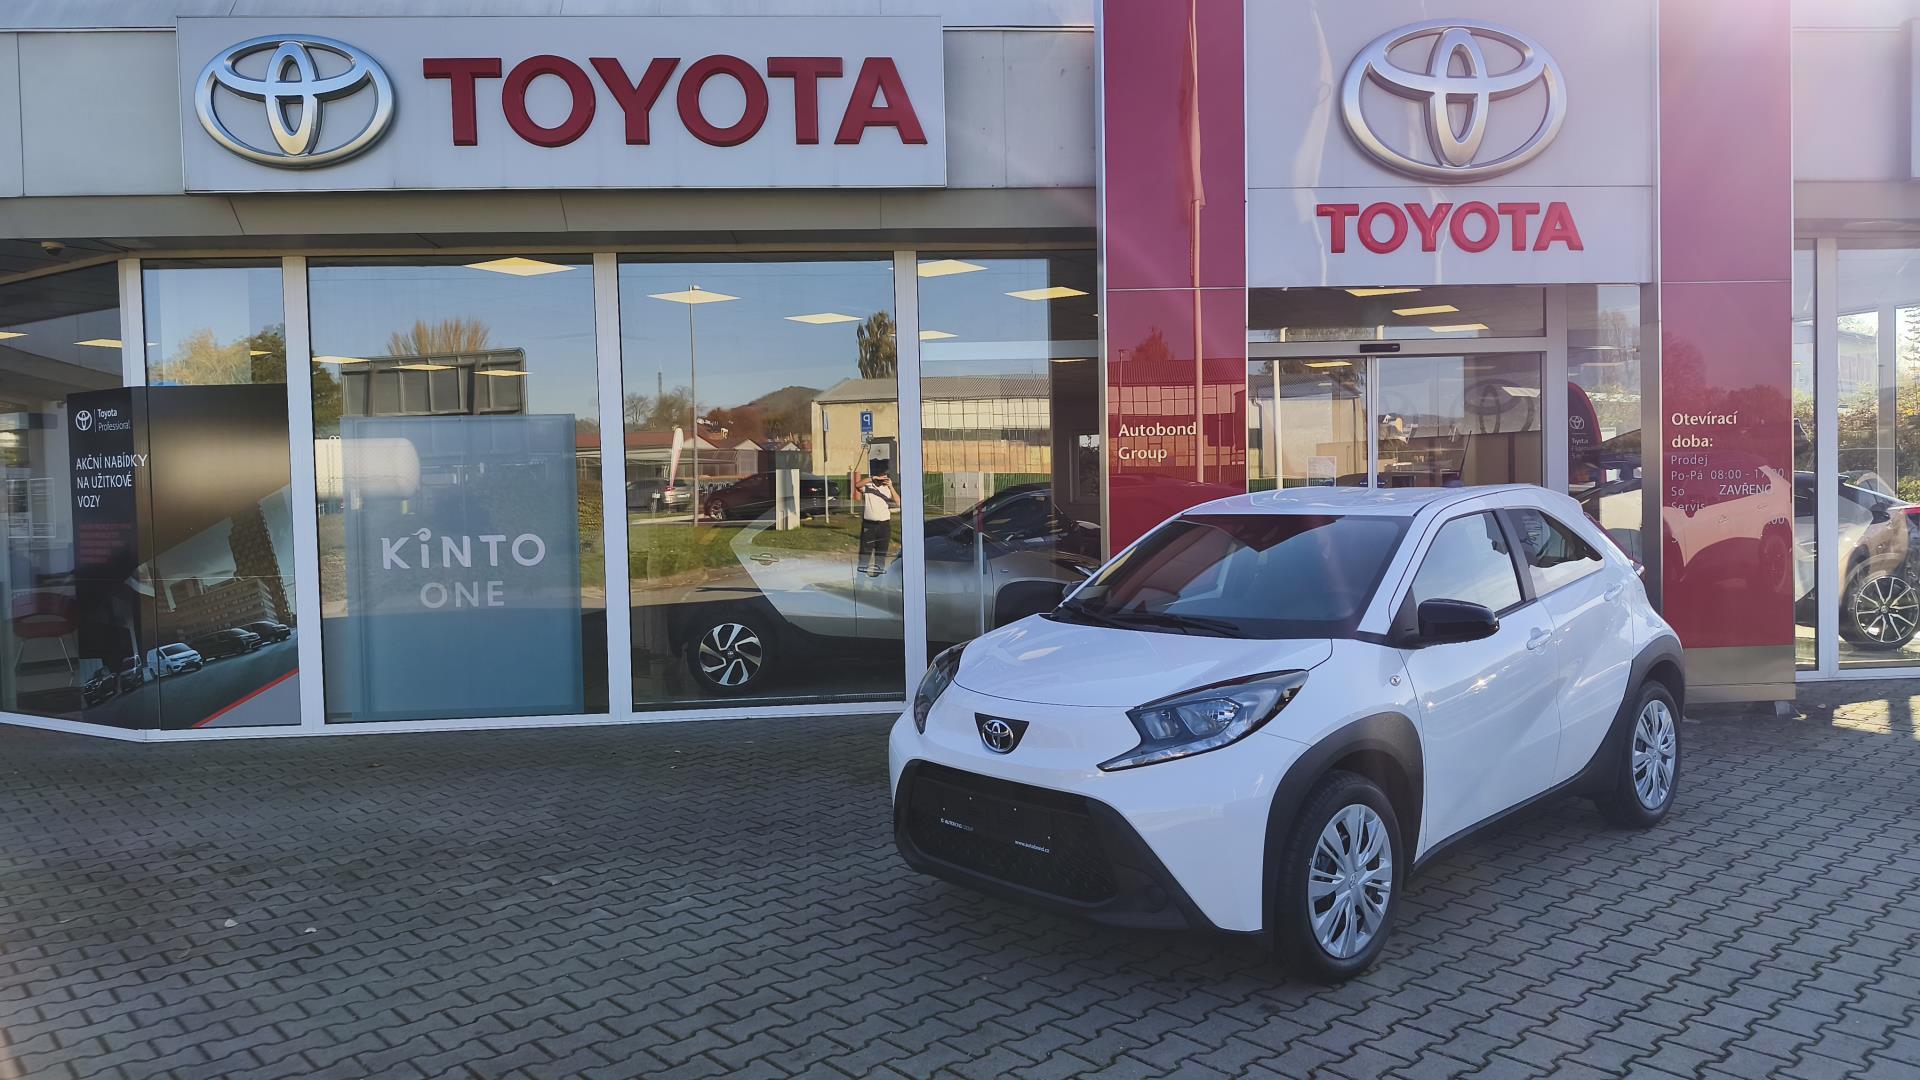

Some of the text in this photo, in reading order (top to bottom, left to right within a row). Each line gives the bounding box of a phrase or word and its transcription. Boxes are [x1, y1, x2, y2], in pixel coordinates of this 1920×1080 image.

[423, 54, 928, 148] TOYOTA
[1316, 201, 1584, 254] TOYOTA
[97, 408, 118, 420] Toyota
[1671, 410, 1738, 426] Otevírací
[98, 420, 131, 432] Professional
[1118, 421, 1197, 437] Autobond
[1671, 434, 1713, 448] doba:
[76, 451, 148, 470] AKČNÍ NABÍDKY
[1118, 446, 1168, 463] Group
[1671, 454, 1708, 467] Prodej
[77, 471, 132, 489] NA UŽITKOVÉ
[1671, 470, 1703, 481] Po-Pá
[1710, 469, 1742, 480] 08:00
[1755, 468, 1785, 479] 170
[1671, 486, 1685, 497] So
[77, 495, 101, 508] VOZY
[1671, 501, 1706, 512] Servis
[420, 581, 505, 609] ONE
